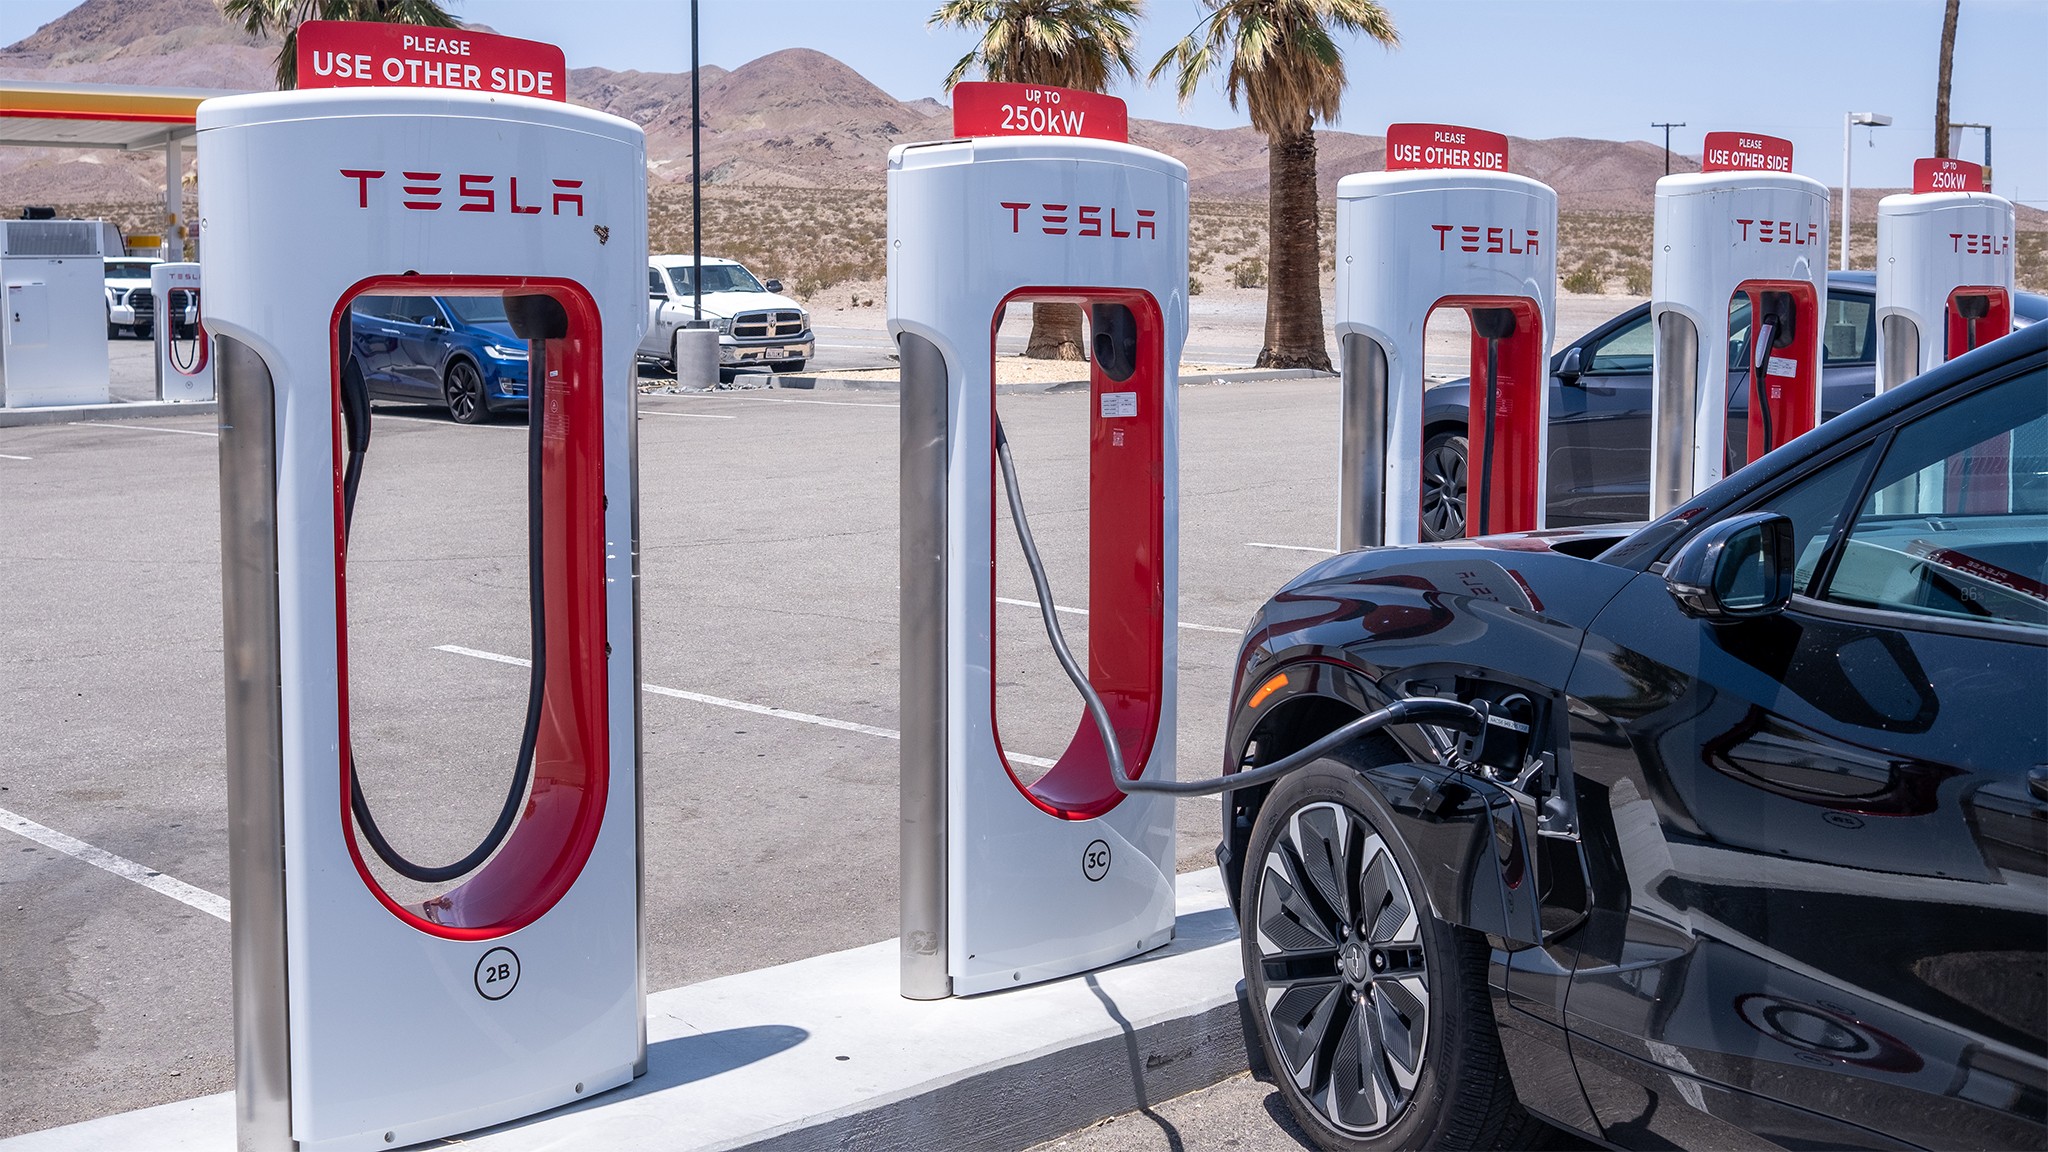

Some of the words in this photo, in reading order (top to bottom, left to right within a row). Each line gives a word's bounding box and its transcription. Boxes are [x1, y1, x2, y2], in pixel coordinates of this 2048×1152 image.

[403, 35, 471, 56] PLEASE
[313, 50, 372, 80] USE
[382, 57, 482, 89] OTHER
[490, 67, 553, 95] SIDE
[1025, 89, 1042, 103] UP
[1044, 91, 1061, 105] TO
[1001, 104, 1085, 136] 250kW
[1434, 131, 1466, 145] PLEASE
[1739, 138, 1763, 150] PLEASE
[1394, 143, 1421, 163] USE
[1424, 146, 1470, 167] OTHER
[1473, 151, 1503, 170] SIDE
[1709, 149, 1730, 166] USE
[1731, 151, 1765, 169] OTHER
[1766, 154, 1789, 171] SIDE
[1942, 162, 1949, 170] UP
[1950, 162, 1957, 170] TO
[1932, 171, 1967, 190] 250kW
[340, 169, 583, 217] TESLA
[1001, 201, 1156, 240] TESLA
[1432, 224, 1539, 256] TESLA
[1736, 219, 1817, 246] TESLA
[1949, 233, 2008, 255] TESLA
[168, 273, 201, 281] TESL
[1088, 851, 1107, 869] 3C
[487, 964, 511, 984] 2B
